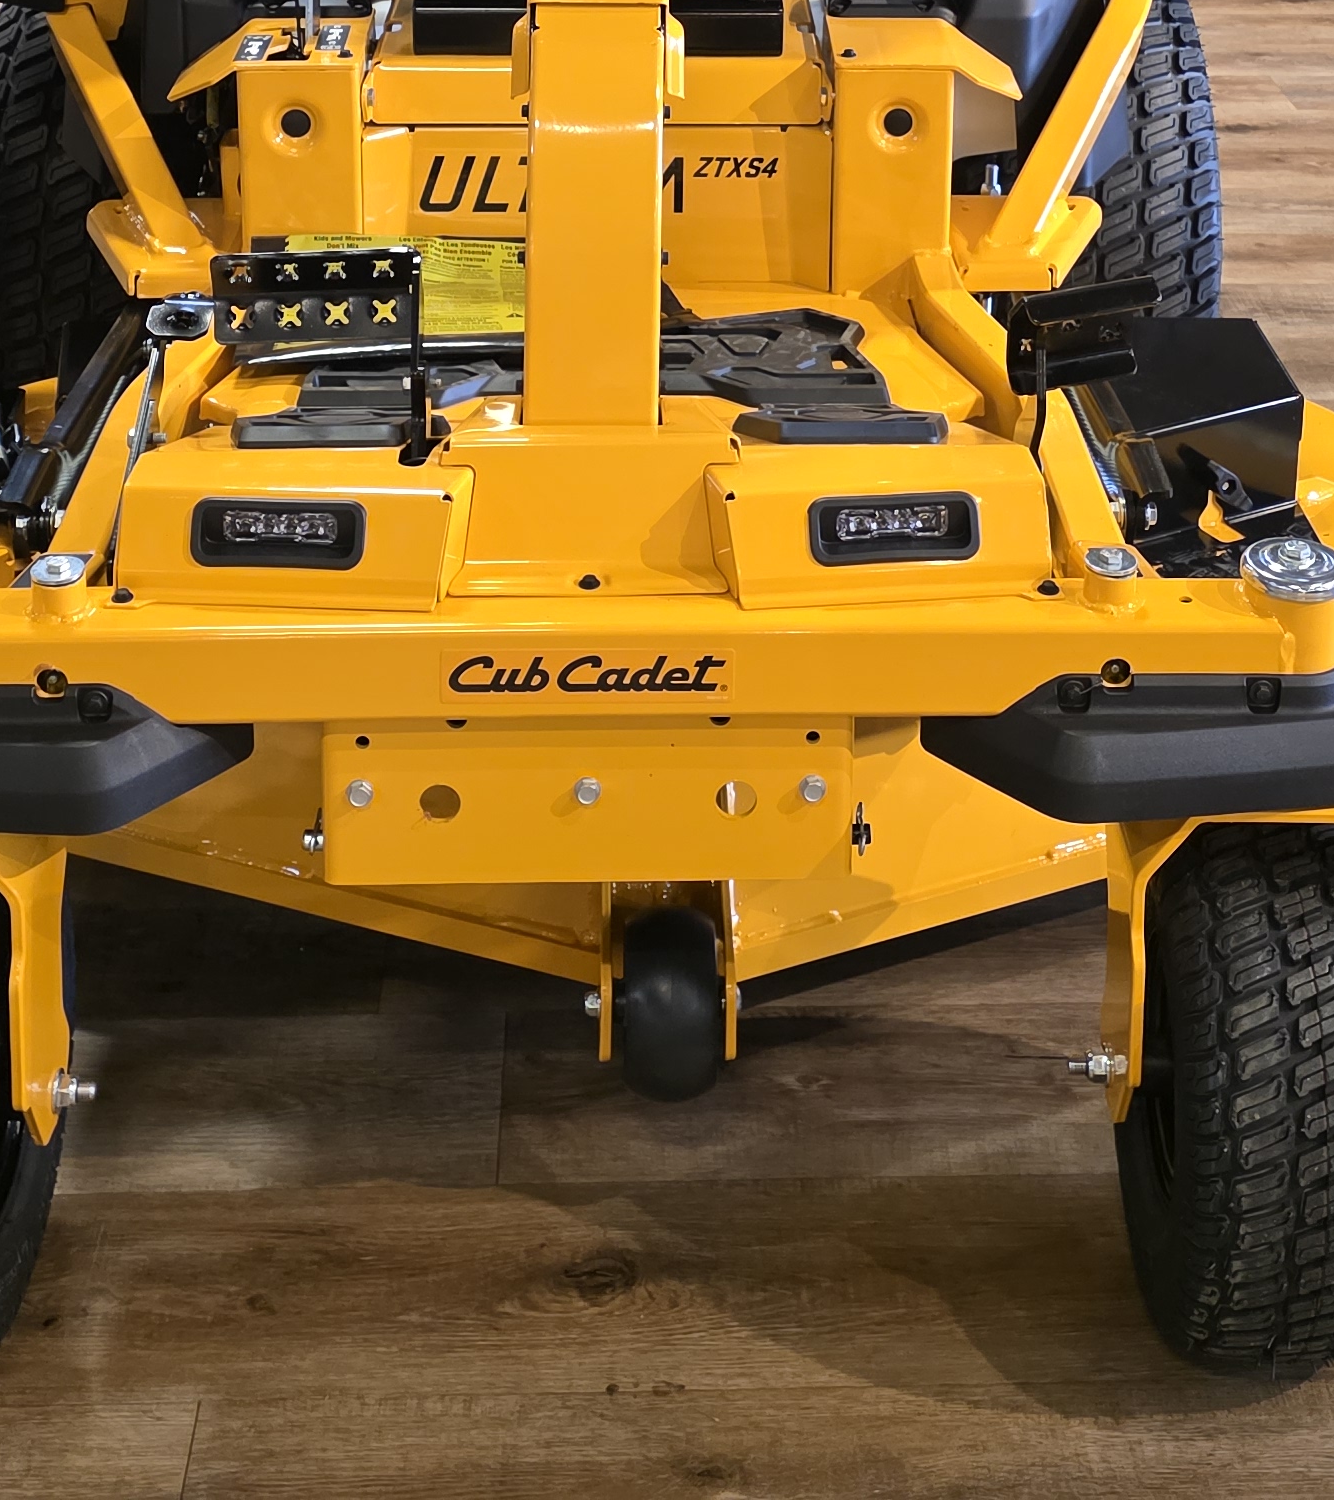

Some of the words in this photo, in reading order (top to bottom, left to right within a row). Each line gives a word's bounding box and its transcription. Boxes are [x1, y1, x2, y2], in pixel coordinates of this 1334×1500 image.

[693, 156, 779, 179] ZTXS4
[448, 655, 550, 693] Cub
[557, 654, 727, 692] Cadet
